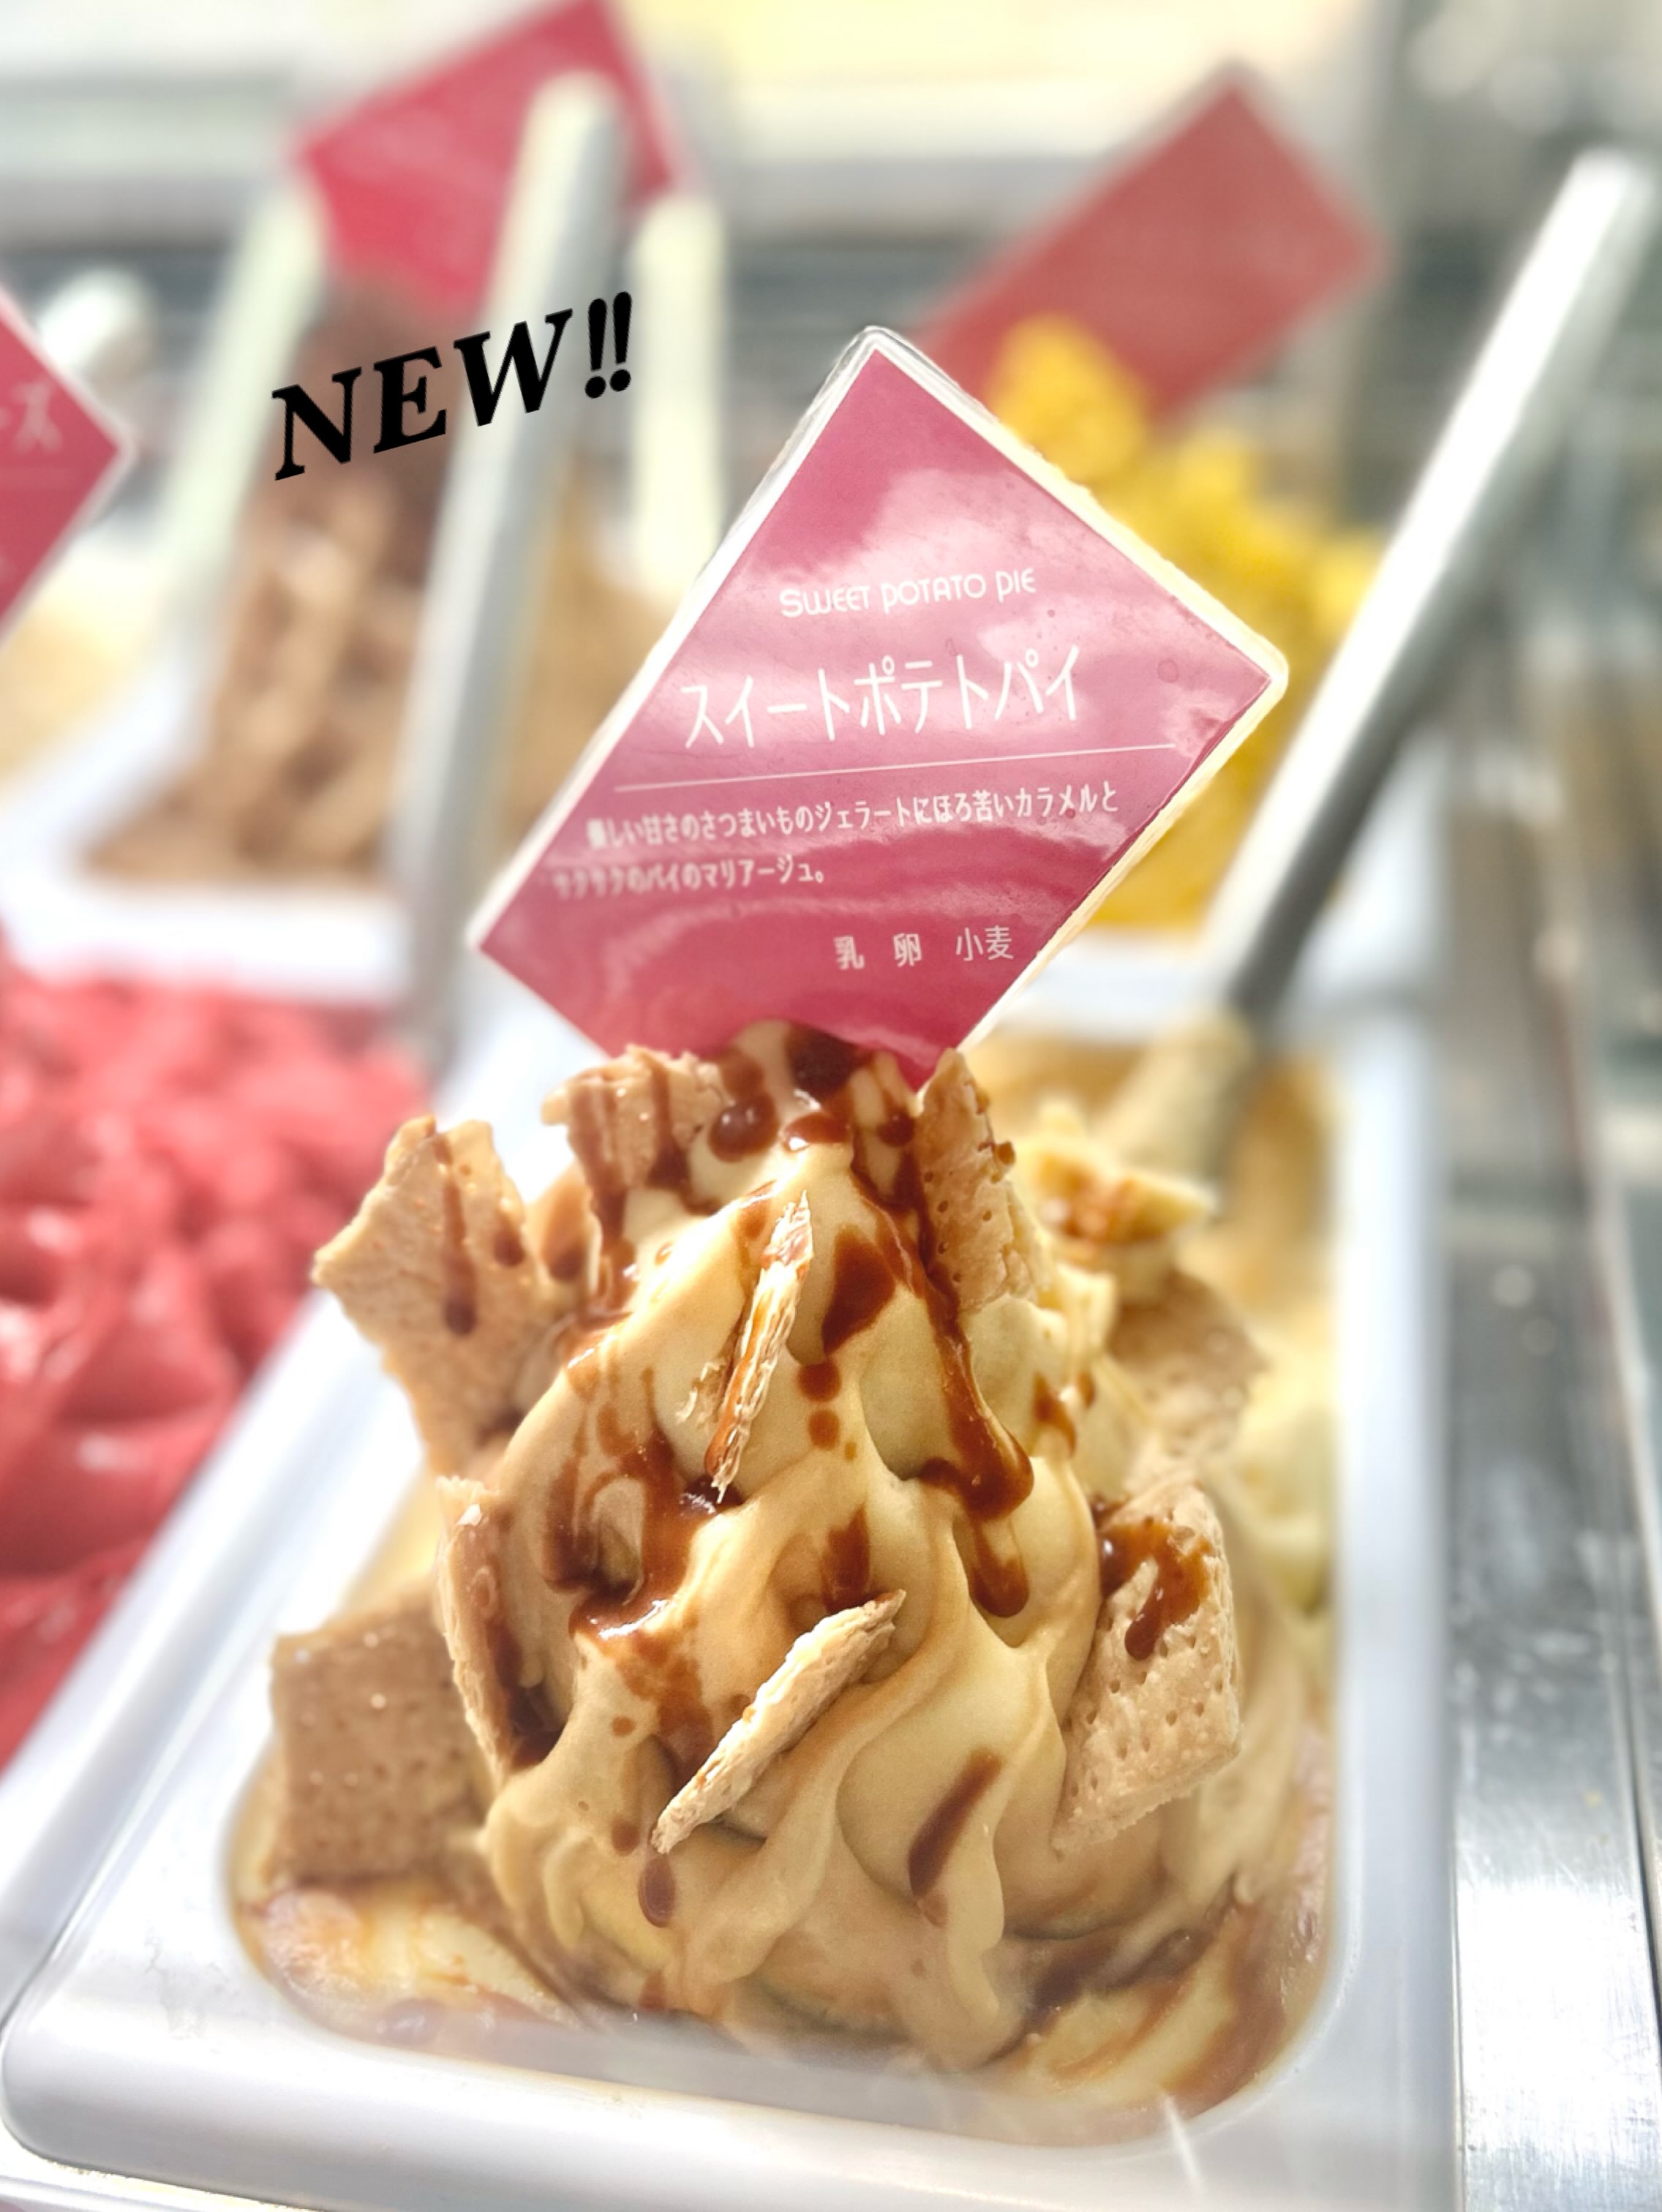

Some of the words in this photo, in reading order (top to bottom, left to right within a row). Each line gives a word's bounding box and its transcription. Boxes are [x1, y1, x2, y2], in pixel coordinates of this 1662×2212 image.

[779, 585, 871, 617] SWEET
[880, 573, 988, 614] POTATO
[995, 568, 1037, 603] PIE
[680, 644, 1080, 749] スイートポテトパイ
[834, 936, 865, 969] 乳
[893, 932, 922, 967] 卵
[955, 925, 1015, 961] 小麦
